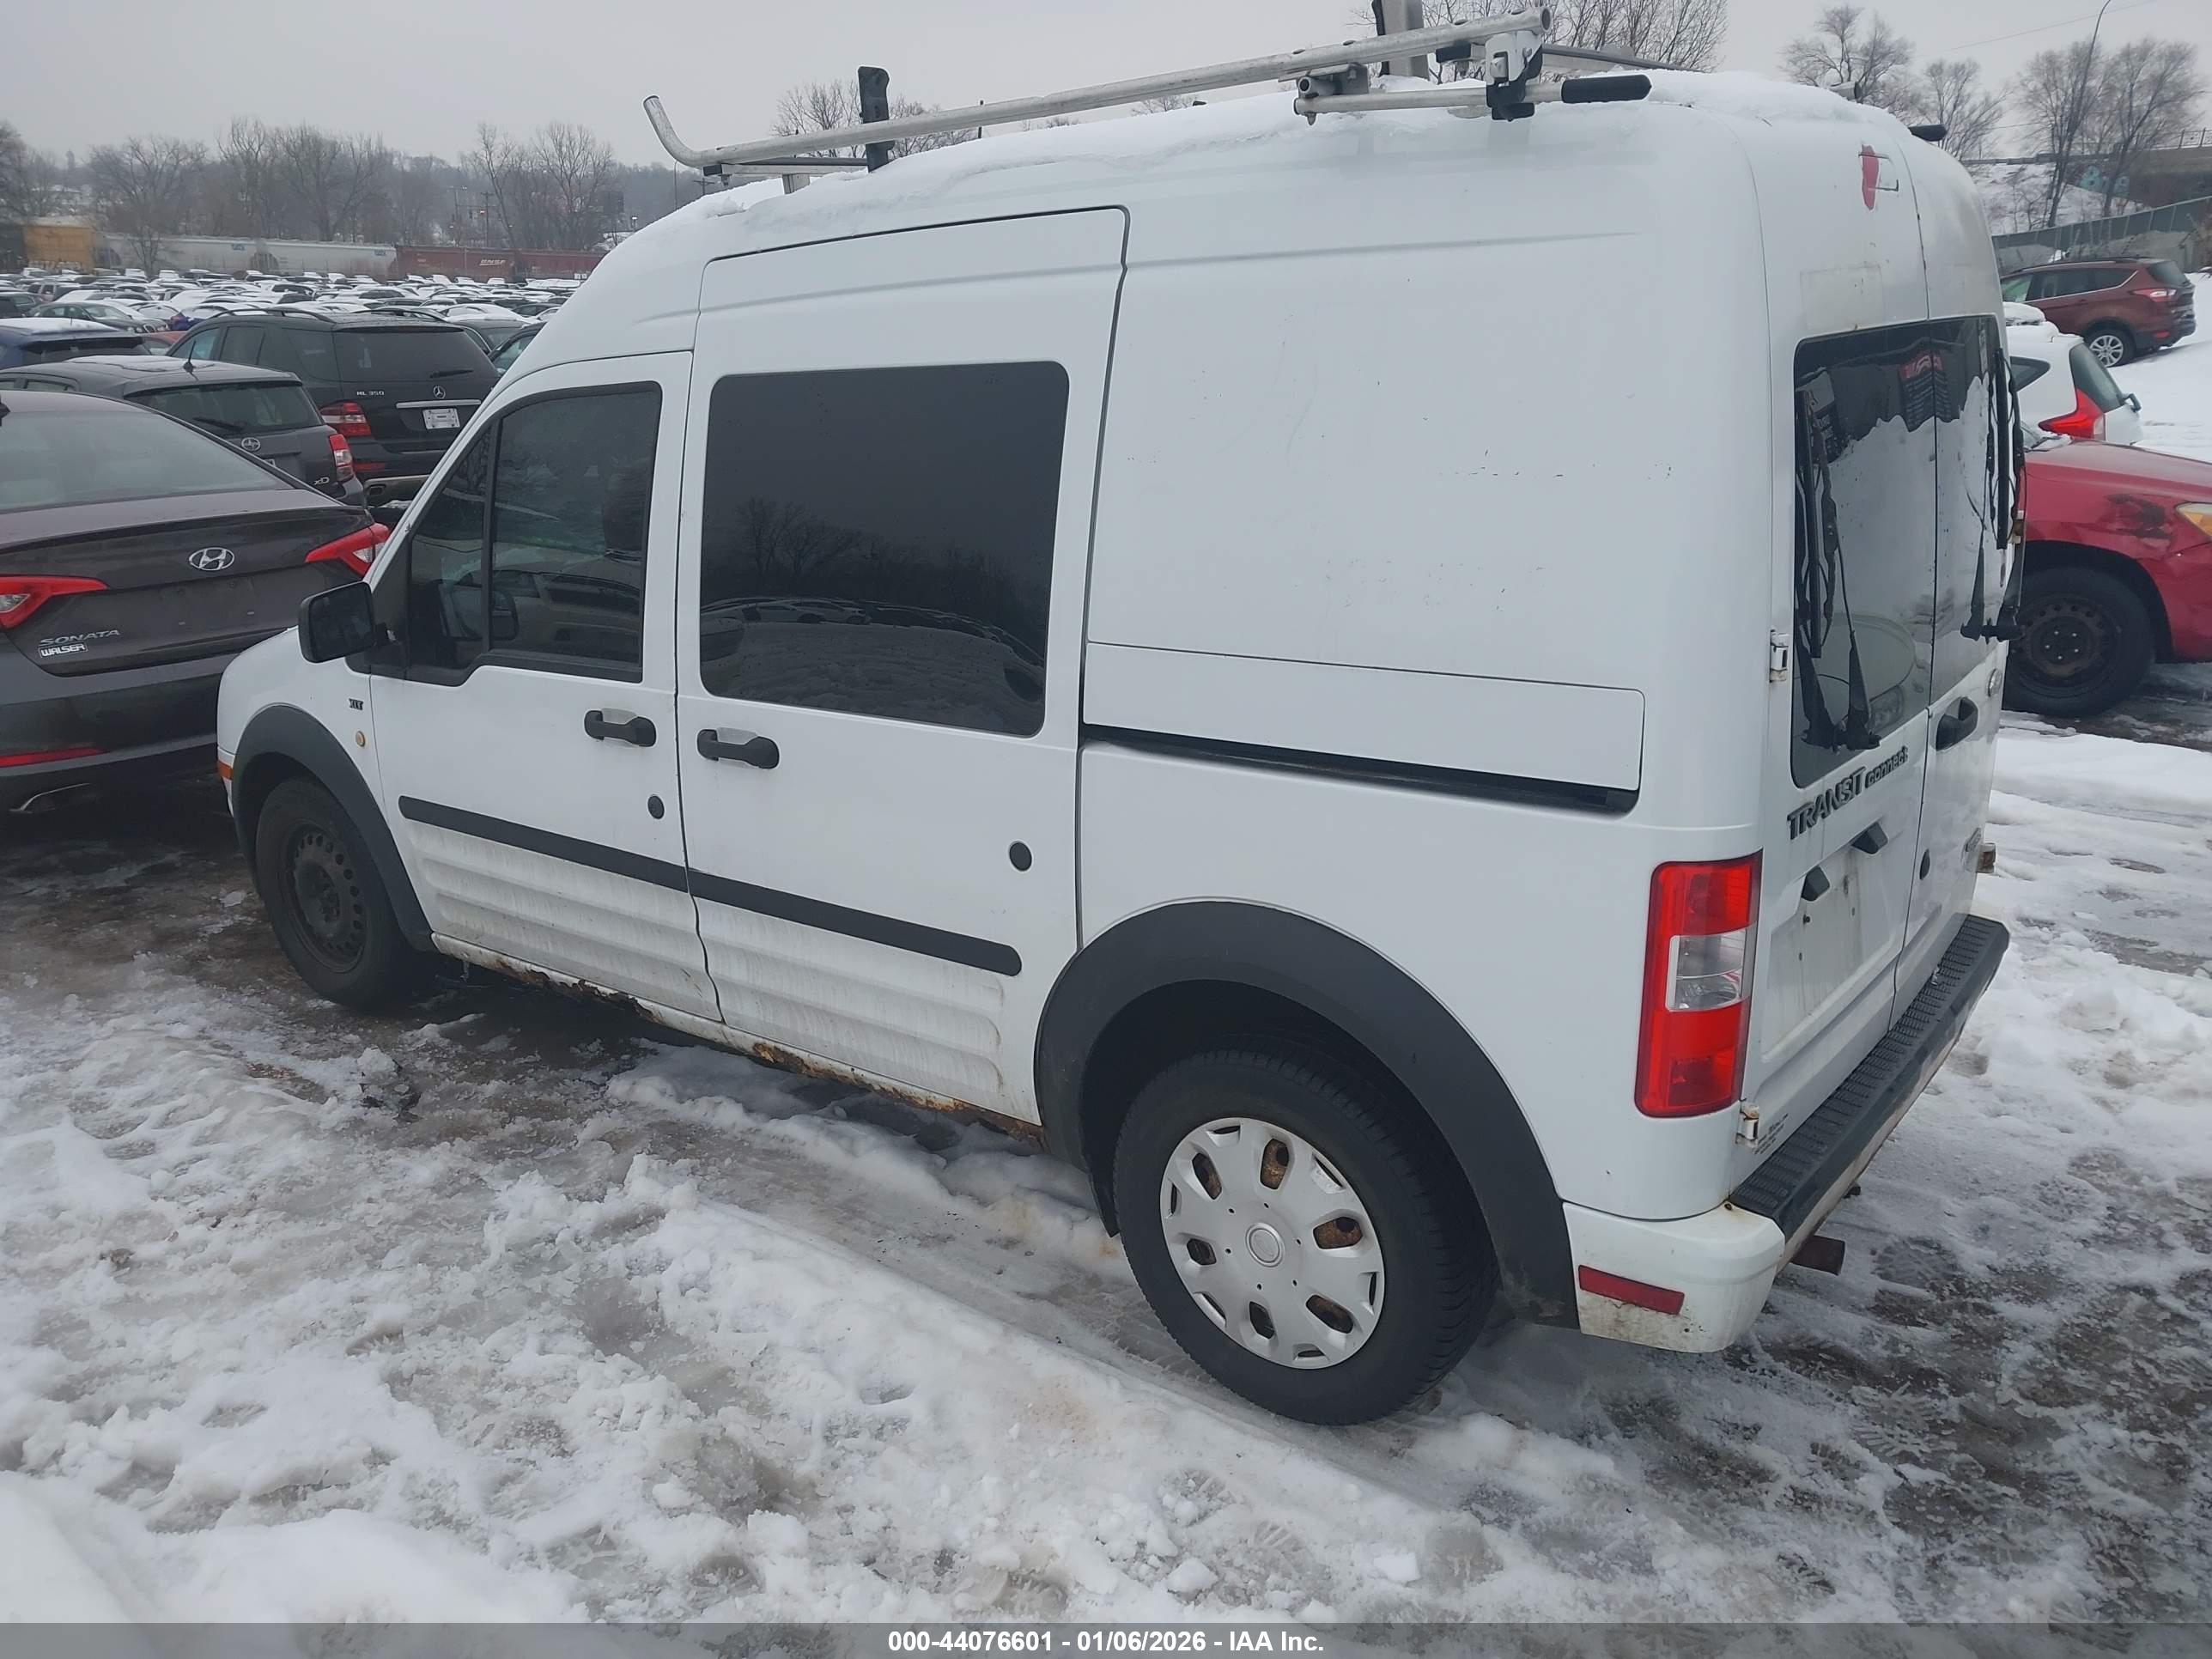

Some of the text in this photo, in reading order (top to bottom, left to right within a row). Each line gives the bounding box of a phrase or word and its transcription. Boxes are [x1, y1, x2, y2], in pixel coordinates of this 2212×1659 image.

[39, 629, 120, 647] SONATA
[40, 643, 86, 657] WALSER
[1786, 745, 1908, 841] TRANSIT connect
